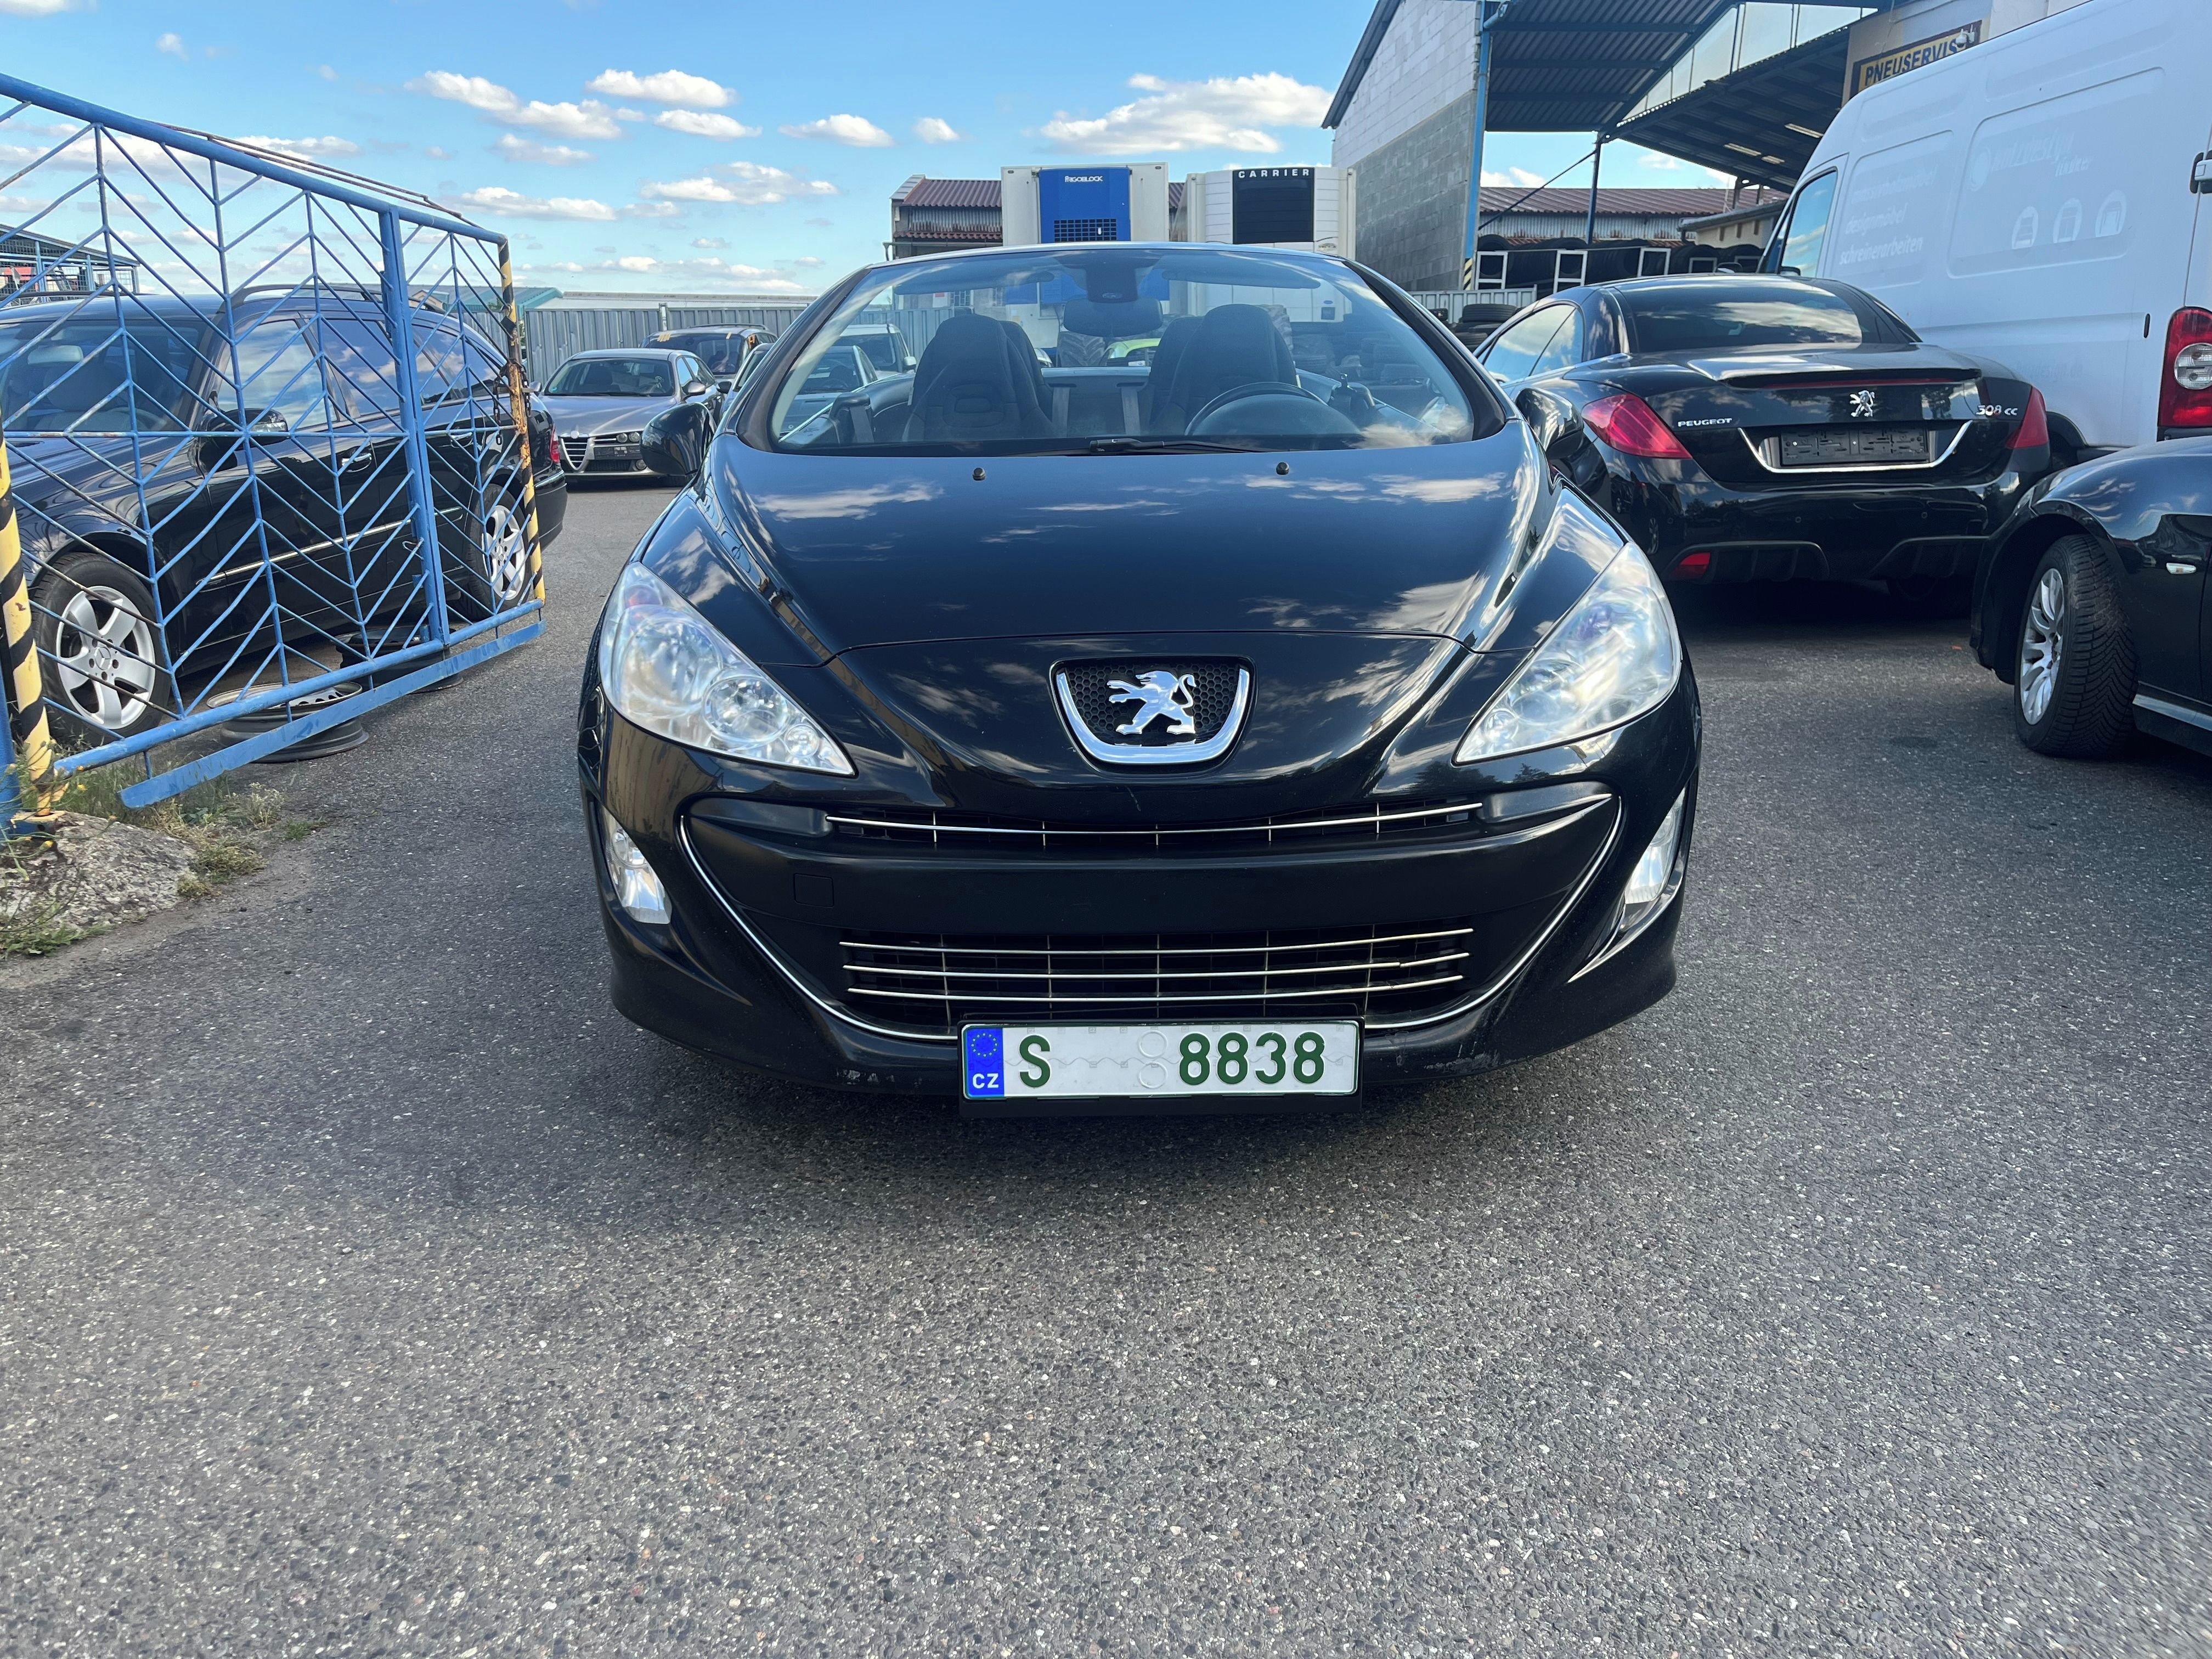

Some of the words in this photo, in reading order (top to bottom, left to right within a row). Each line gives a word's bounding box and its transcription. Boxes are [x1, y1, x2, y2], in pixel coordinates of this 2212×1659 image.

[1865, 37, 1959, 86] PNEUSERVIS
[1238, 168, 1310, 178] CARRIER
[1839, 234, 1923, 264] schreinerarbeiten
[1976, 405, 2002, 416] 308
[1678, 418, 1732, 427] PEUGEOT
[1179, 1031, 1325, 1086] 8838
[972, 1073, 1000, 1088] CZ
